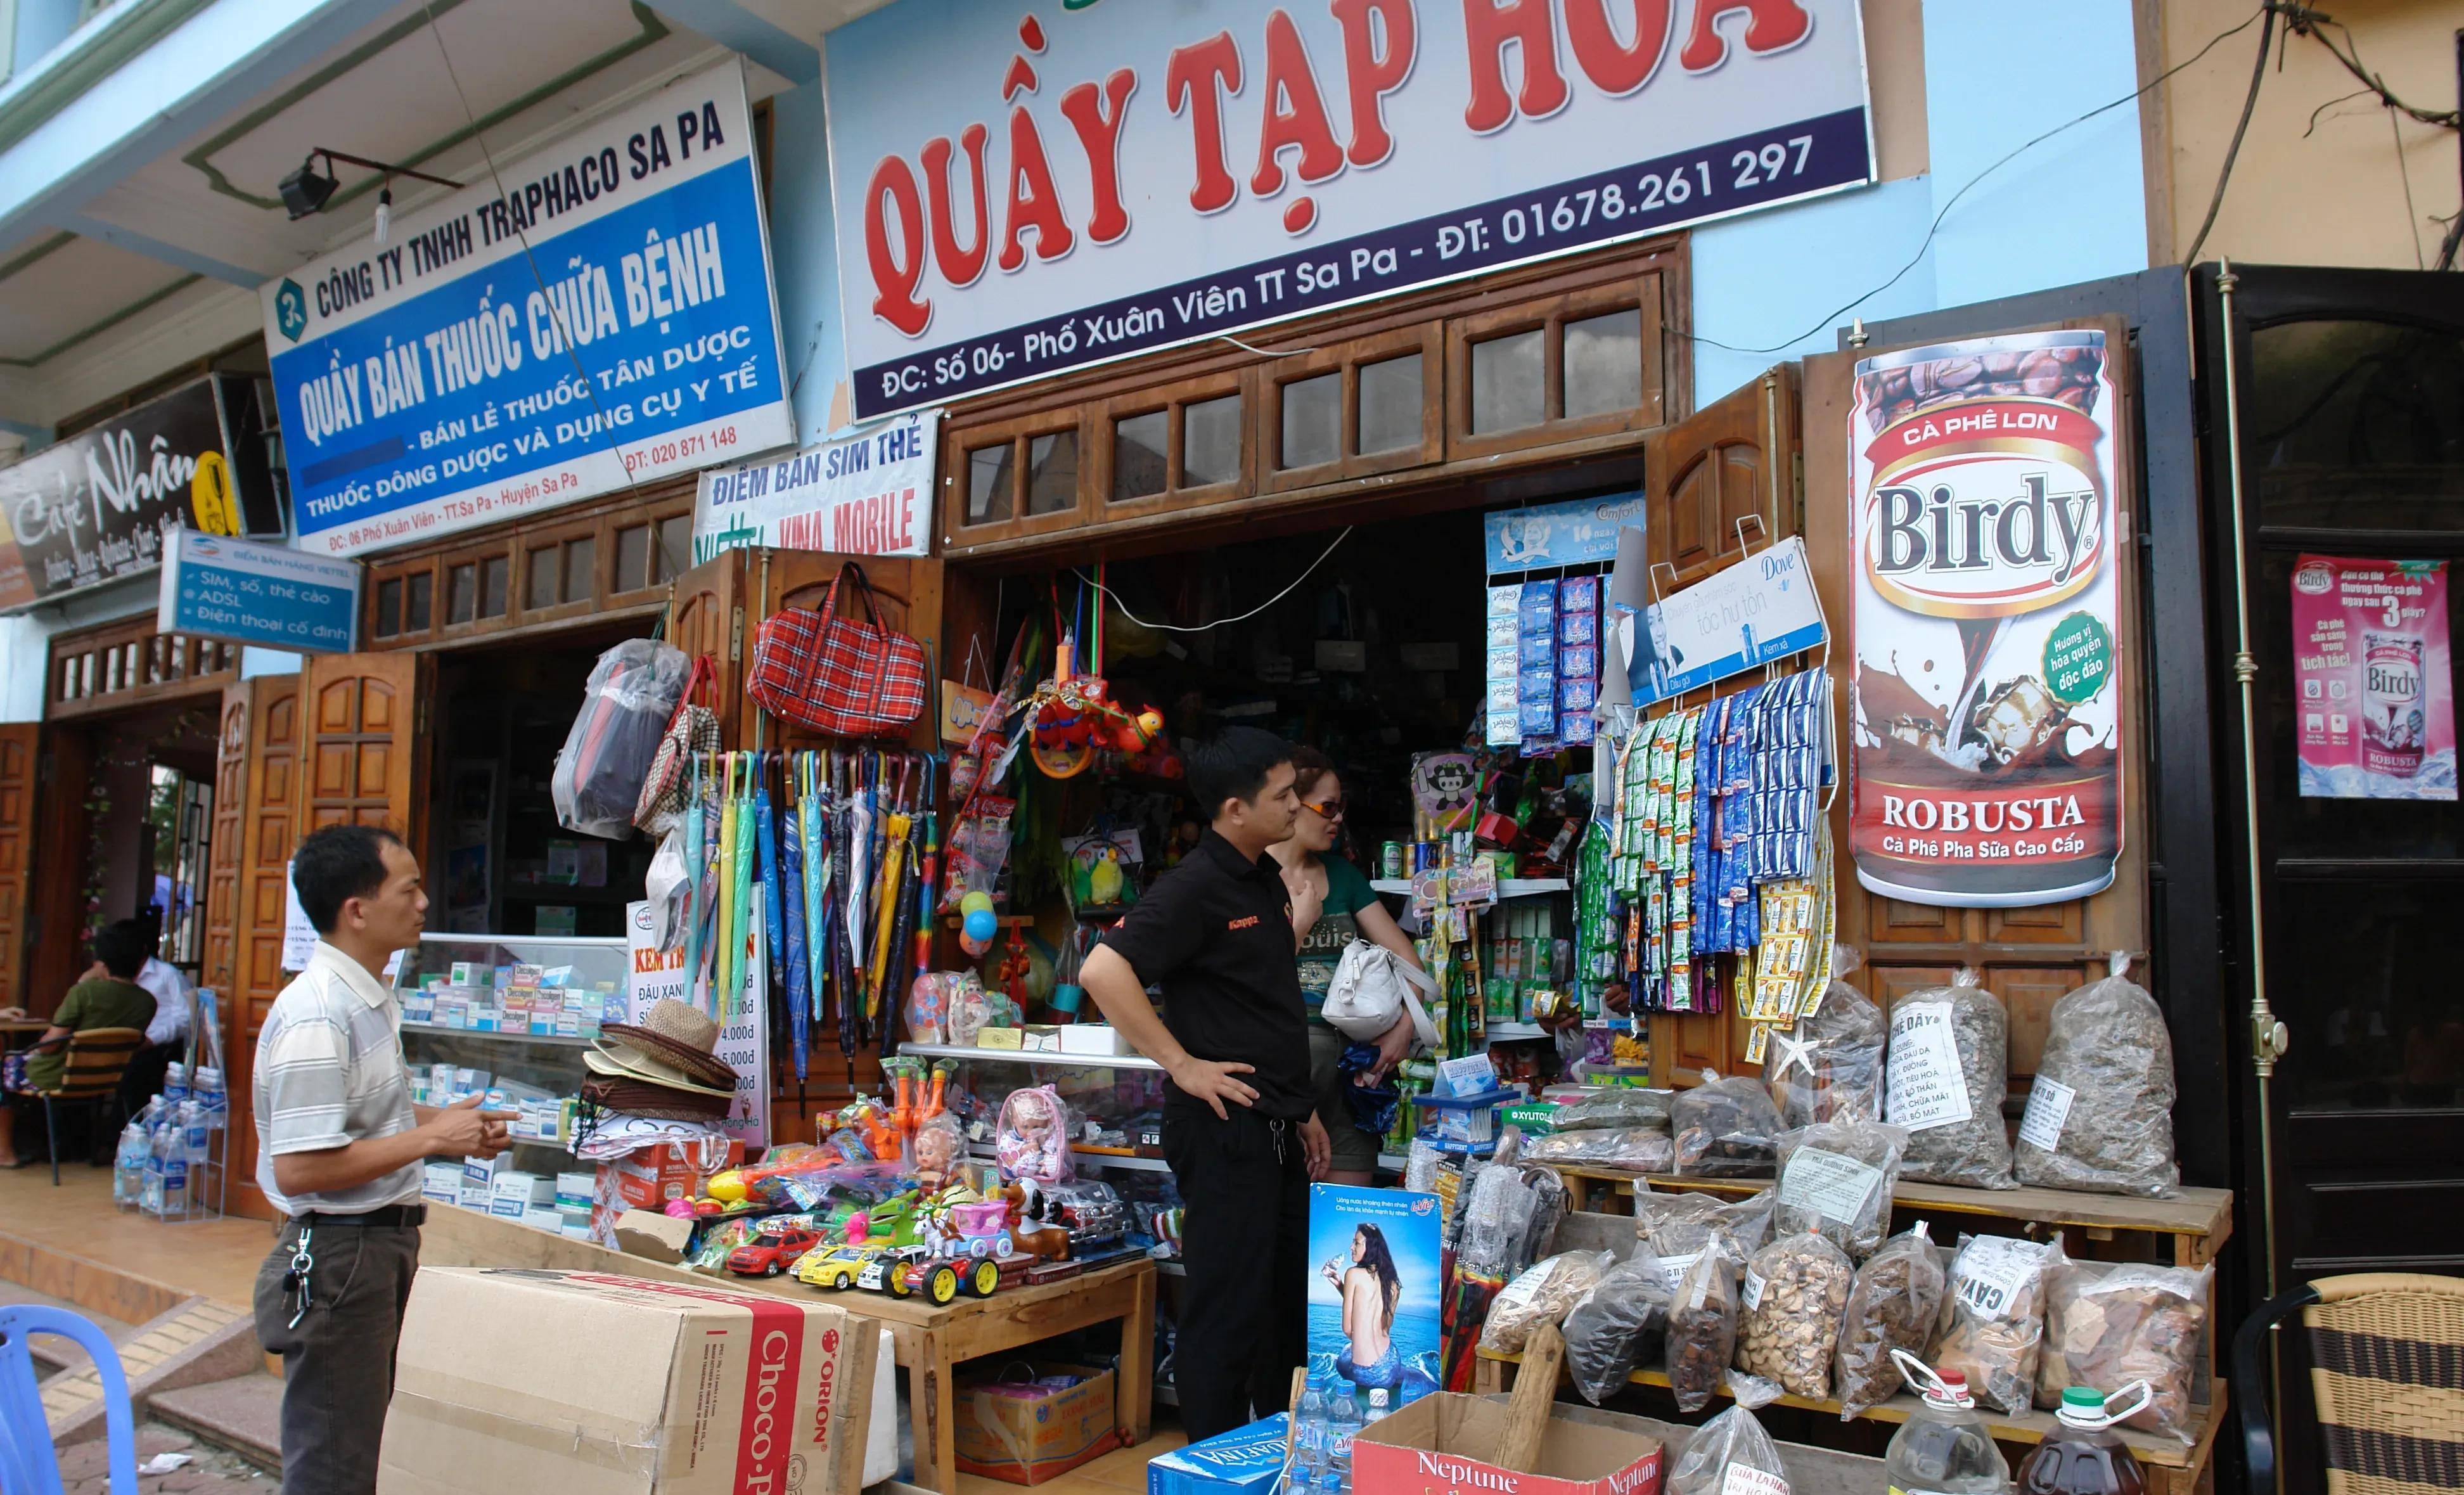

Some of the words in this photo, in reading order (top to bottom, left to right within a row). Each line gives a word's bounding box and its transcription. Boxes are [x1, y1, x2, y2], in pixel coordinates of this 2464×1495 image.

[864, 14, 1136, 337] QUẦY
[1167, 0, 1416, 234] TẠP
[317, 264, 373, 318] CÔNG
[377, 247, 403, 291] TY
[409, 219, 472, 276] TNHH
[477, 146, 619, 247] TRAPHACO
[627, 129, 671, 179] SA
[677, 100, 725, 160] PA
[882, 366, 927, 398] ĐC:
[934, 350, 966, 385] Số
[1025, 324, 1077, 363] Phố
[1086, 303, 1165, 349] Xuân
[1172, 285, 1246, 324] Viên
[1254, 269, 1285, 302] TT
[1296, 260, 1340, 294] Sa
[1352, 248, 1397, 281] Pa
[1436, 217, 1490, 260] ĐT:
[1502, 160, 1714, 245] 01678.261
[1731, 135, 1814, 190] 297
[299, 348, 359, 447] QUẦY
[366, 335, 426, 419] BÁN
[425, 283, 522, 390] THUỐC
[527, 255, 619, 363] CHỮA
[620, 221, 726, 335] BỆNH
[419, 421, 466, 452] BÁN
[472, 406, 500, 435] LẺ
[503, 371, 590, 423] THUỐC
[596, 353, 655, 393] TÂN
[663, 324, 752, 371] DƯỢC
[305, 478, 372, 520] THUỐC
[375, 459, 437, 499] ĐÔNG
[442, 437, 509, 480] DƯỢC
[517, 426, 551, 458] VÀ
[555, 405, 634, 451] DỤNG
[640, 388, 684, 423] CỤ
[689, 379, 712, 402] Y
[723, 355, 760, 393] TẾ
[1903, 420, 1941, 446] CÀ
[1946, 409, 1998, 434] PHÊ
[2003, 413, 2058, 431] LON
[626, 451, 648, 472] ĐT:
[651, 443, 676, 465] 020
[681, 434, 705, 457] 871
[710, 426, 736, 449] 148
[826, 439, 869, 480] SIM
[877, 413, 922, 465] THẺ
[86, 428, 199, 534] Nhân
[329, 534, 347, 551] ĐC:
[349, 530, 361, 545] 06
[362, 521, 382, 543] Phố
[385, 517, 410, 537] Xuân
[413, 511, 435, 530] Viên
[444, 499, 475, 520] TT.Sa
[477, 496, 492, 513] Pa
[501, 484, 539, 506] Huyện
[542, 477, 558, 494] Sa
[560, 472, 577, 489] Pa
[833, 487, 914, 555] MOBILE
[1596, 500, 1641, 523] Comfort
[1874, 472, 2096, 587] Birdy
[1761, 552, 1795, 581] Dove
[2299, 571, 2330, 587] Birdy
[198, 590, 242, 607] ADSL
[1697, 610, 1720, 636] tóc
[1721, 601, 1741, 626] hư
[1742, 586, 1767, 617] tổn
[2382, 594, 2401, 627] 3
[197, 606, 236, 625] Điện
[241, 613, 282, 632] thoại
[1763, 641, 1780, 657] Kem
[2050, 653, 2070, 672] hòa
[2071, 636, 2102, 663] quyện
[2054, 628, 2082, 653] Hương
[2083, 623, 2092, 639] vị
[2058, 668, 2080, 693] độc
[2081, 655, 2104, 679] đáo
[2368, 667, 2420, 698] Birdy
[2369, 752, 2417, 767] ROBUSTA
[1882, 793, 2086, 833] ROBUSTA
[1883, 835, 1904, 854] Cà
[1908, 837, 1939, 857] Phê
[1944, 840, 1974, 859] Pha
[1979, 837, 2010, 858] Sữa
[2014, 838, 2048, 856] Cao
[2051, 831, 2085, 854] Cấp
[1228, 916, 1260, 931] Kappa
[1301, 928, 1352, 949] ouis
[517, 965, 541, 975] Decolgen
[634, 946, 664, 973] KEM
[508, 987, 534, 999] Decolgen
[638, 984, 659, 1004] ĐẬU
[721, 1024, 754, 1041] 4.000đ
[1907, 1013, 1933, 1031] DÂY
[813, 1361, 834, 1443] ORION
[1188, 1439, 1288, 1465] UAFINA
[1417, 1451, 1518, 1494] Neptune
